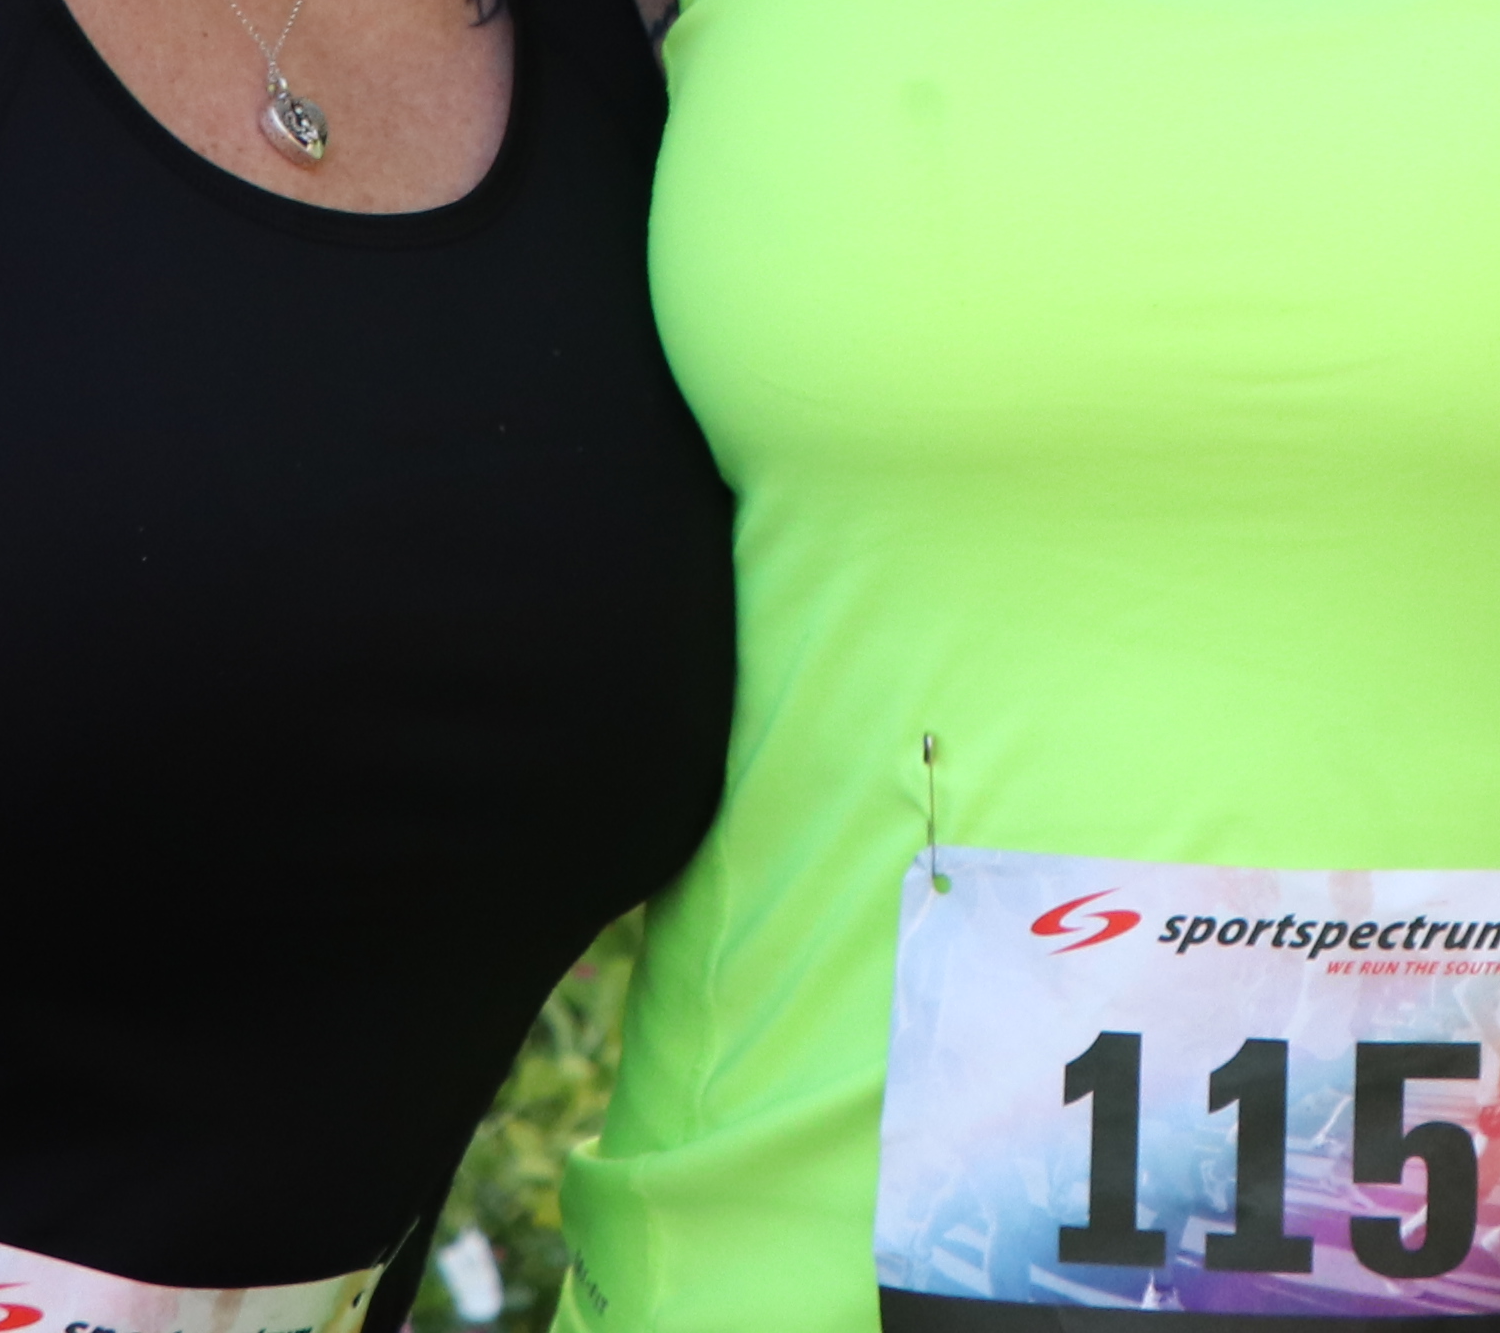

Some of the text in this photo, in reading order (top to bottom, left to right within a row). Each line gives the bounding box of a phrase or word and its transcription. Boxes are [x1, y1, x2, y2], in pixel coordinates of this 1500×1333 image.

[1327, 961, 1355, 975] WE
[1360, 961, 1399, 975] RUN
[1405, 961, 1437, 975] THE
[1058, 1030, 1481, 1280] 115
